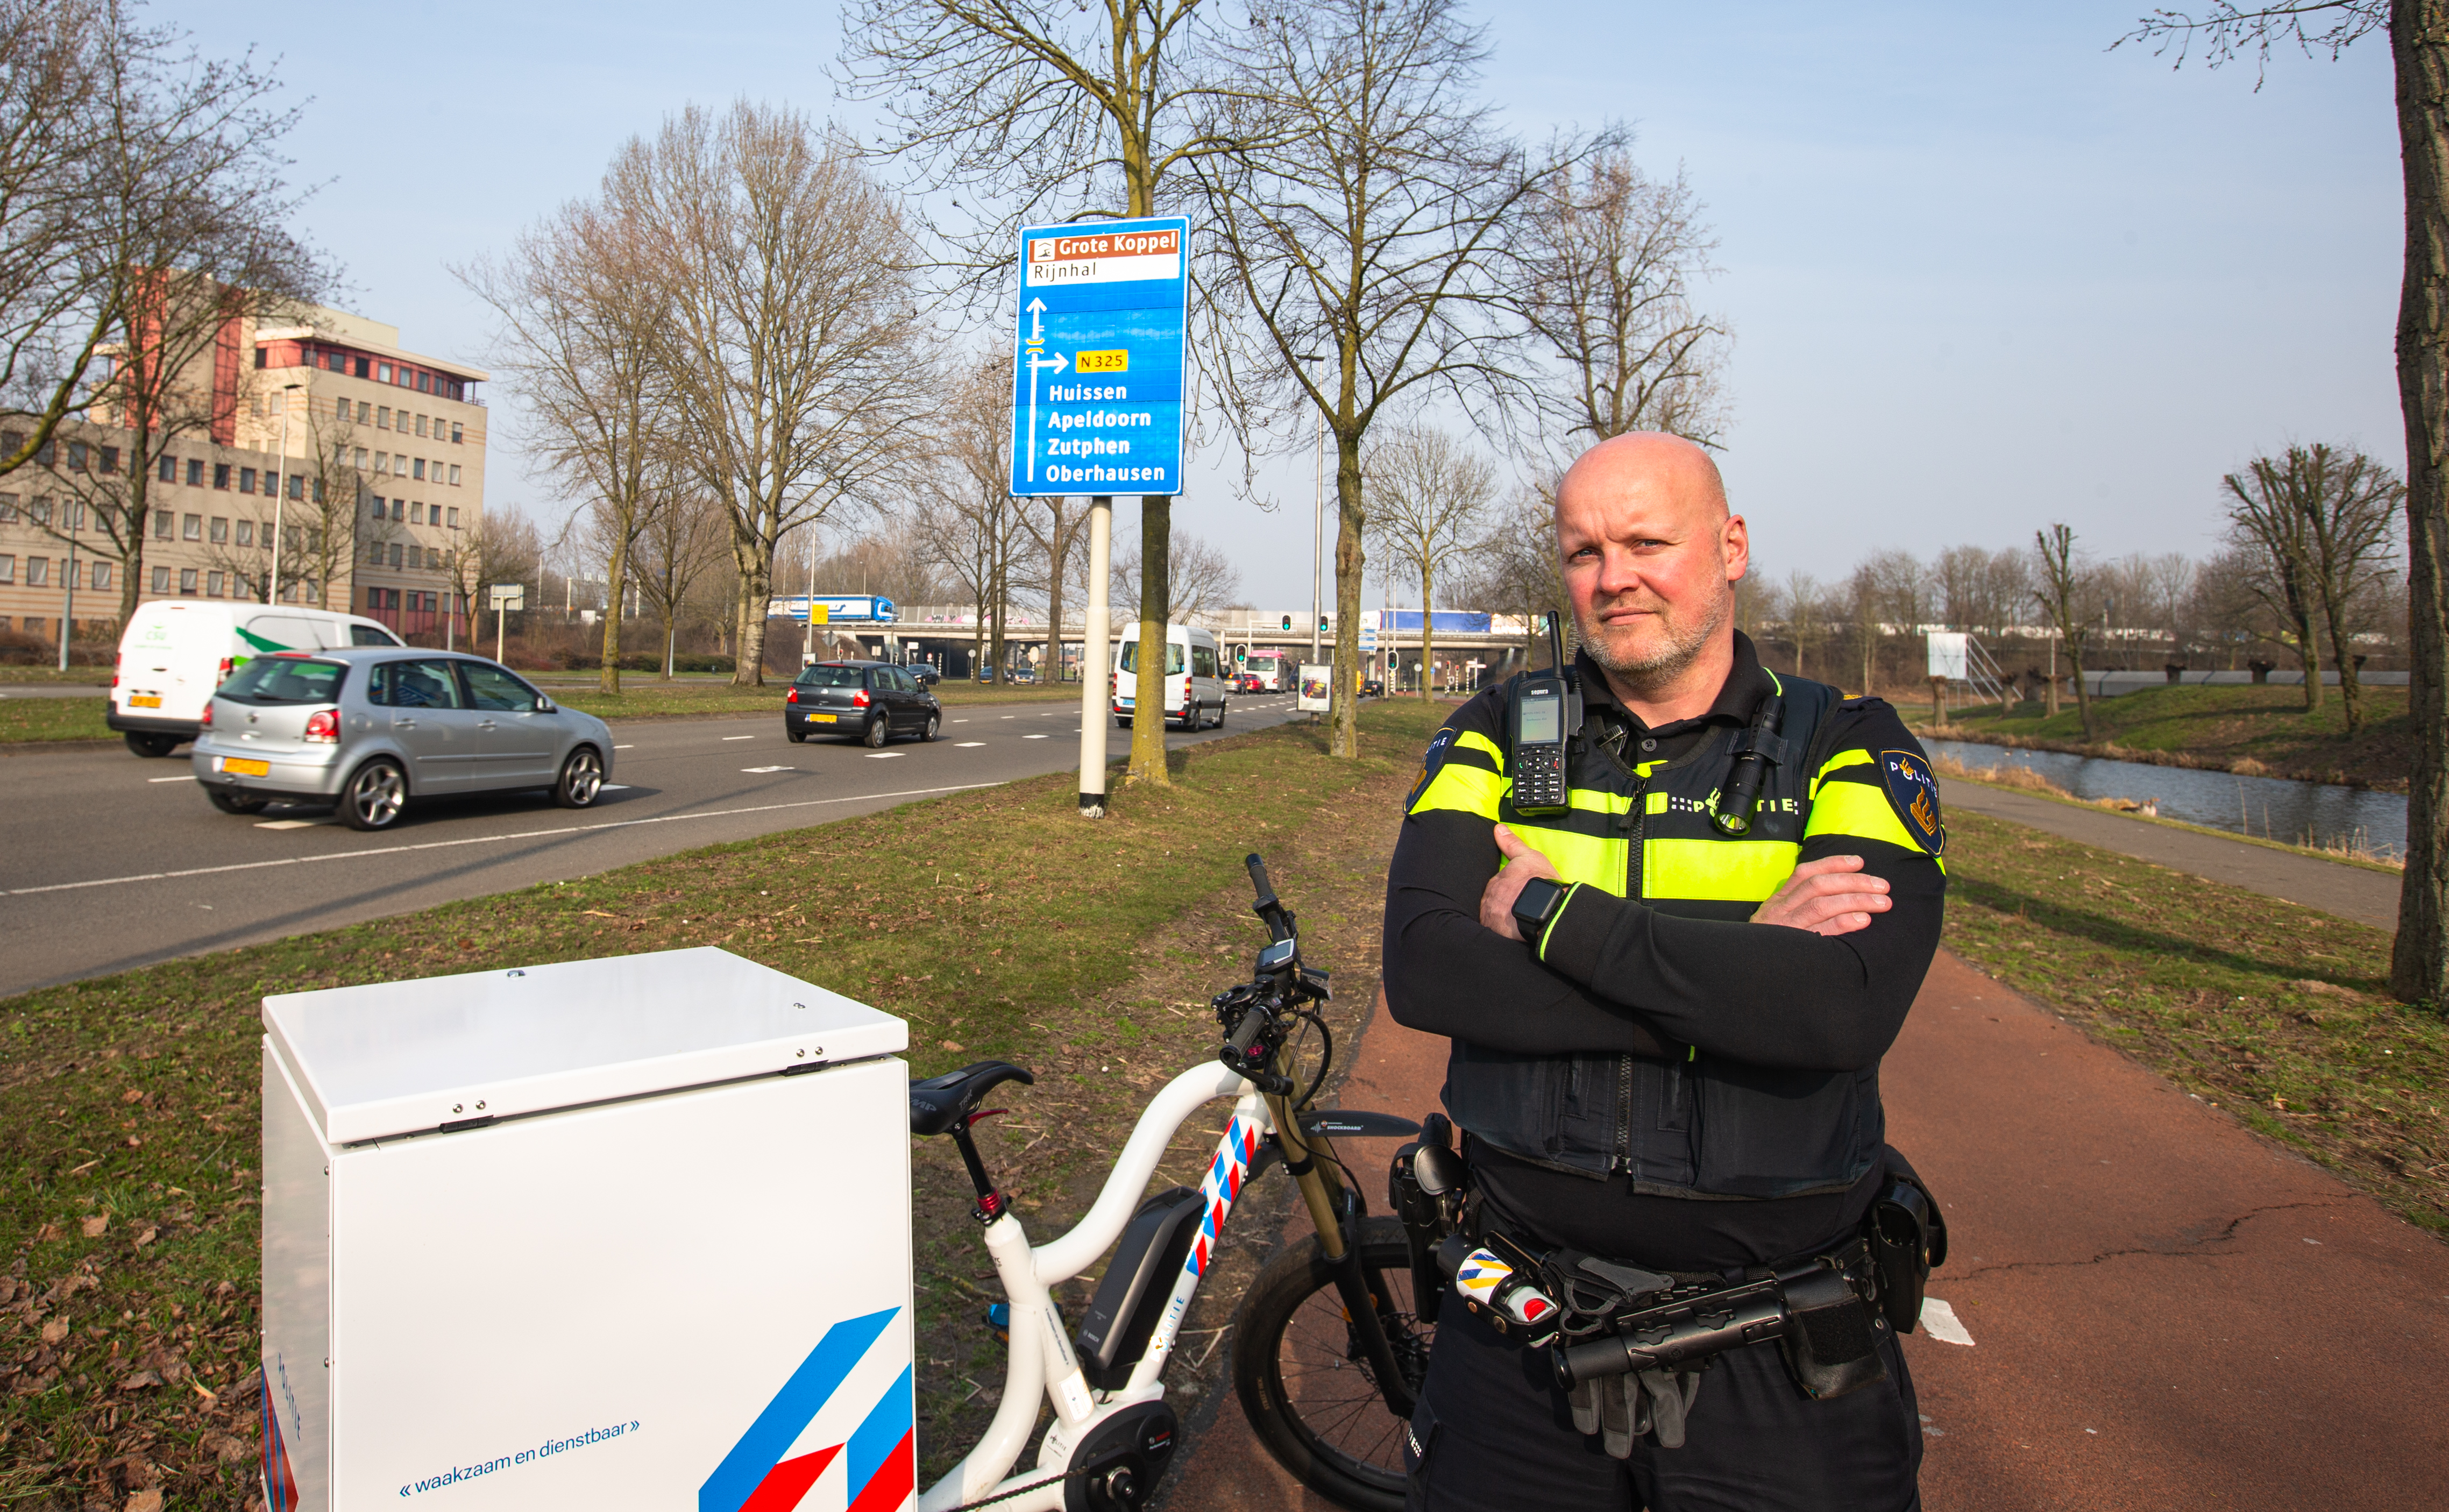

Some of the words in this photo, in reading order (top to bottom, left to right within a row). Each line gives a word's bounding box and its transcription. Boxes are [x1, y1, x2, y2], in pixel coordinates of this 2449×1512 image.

[1059, 239, 1108, 255] Grote
[1114, 232, 1176, 253] Koppel
[1034, 262, 1096, 282] Rijnhal
[1049, 384, 1127, 402] Huissen
[1048, 410, 1151, 432] Apeldoorn
[1047, 438, 1130, 459] Zutphen
[1046, 464, 1165, 482] Oberhausen
[1693, 798, 1794, 817] PTIE
[911, 1098, 937, 1112] MP
[279, 1352, 300, 1442] POLITIE
[415, 1456, 510, 1493] waakzaam
[515, 1449, 535, 1464] en
[540, 1423, 627, 1458] dienstbaar
